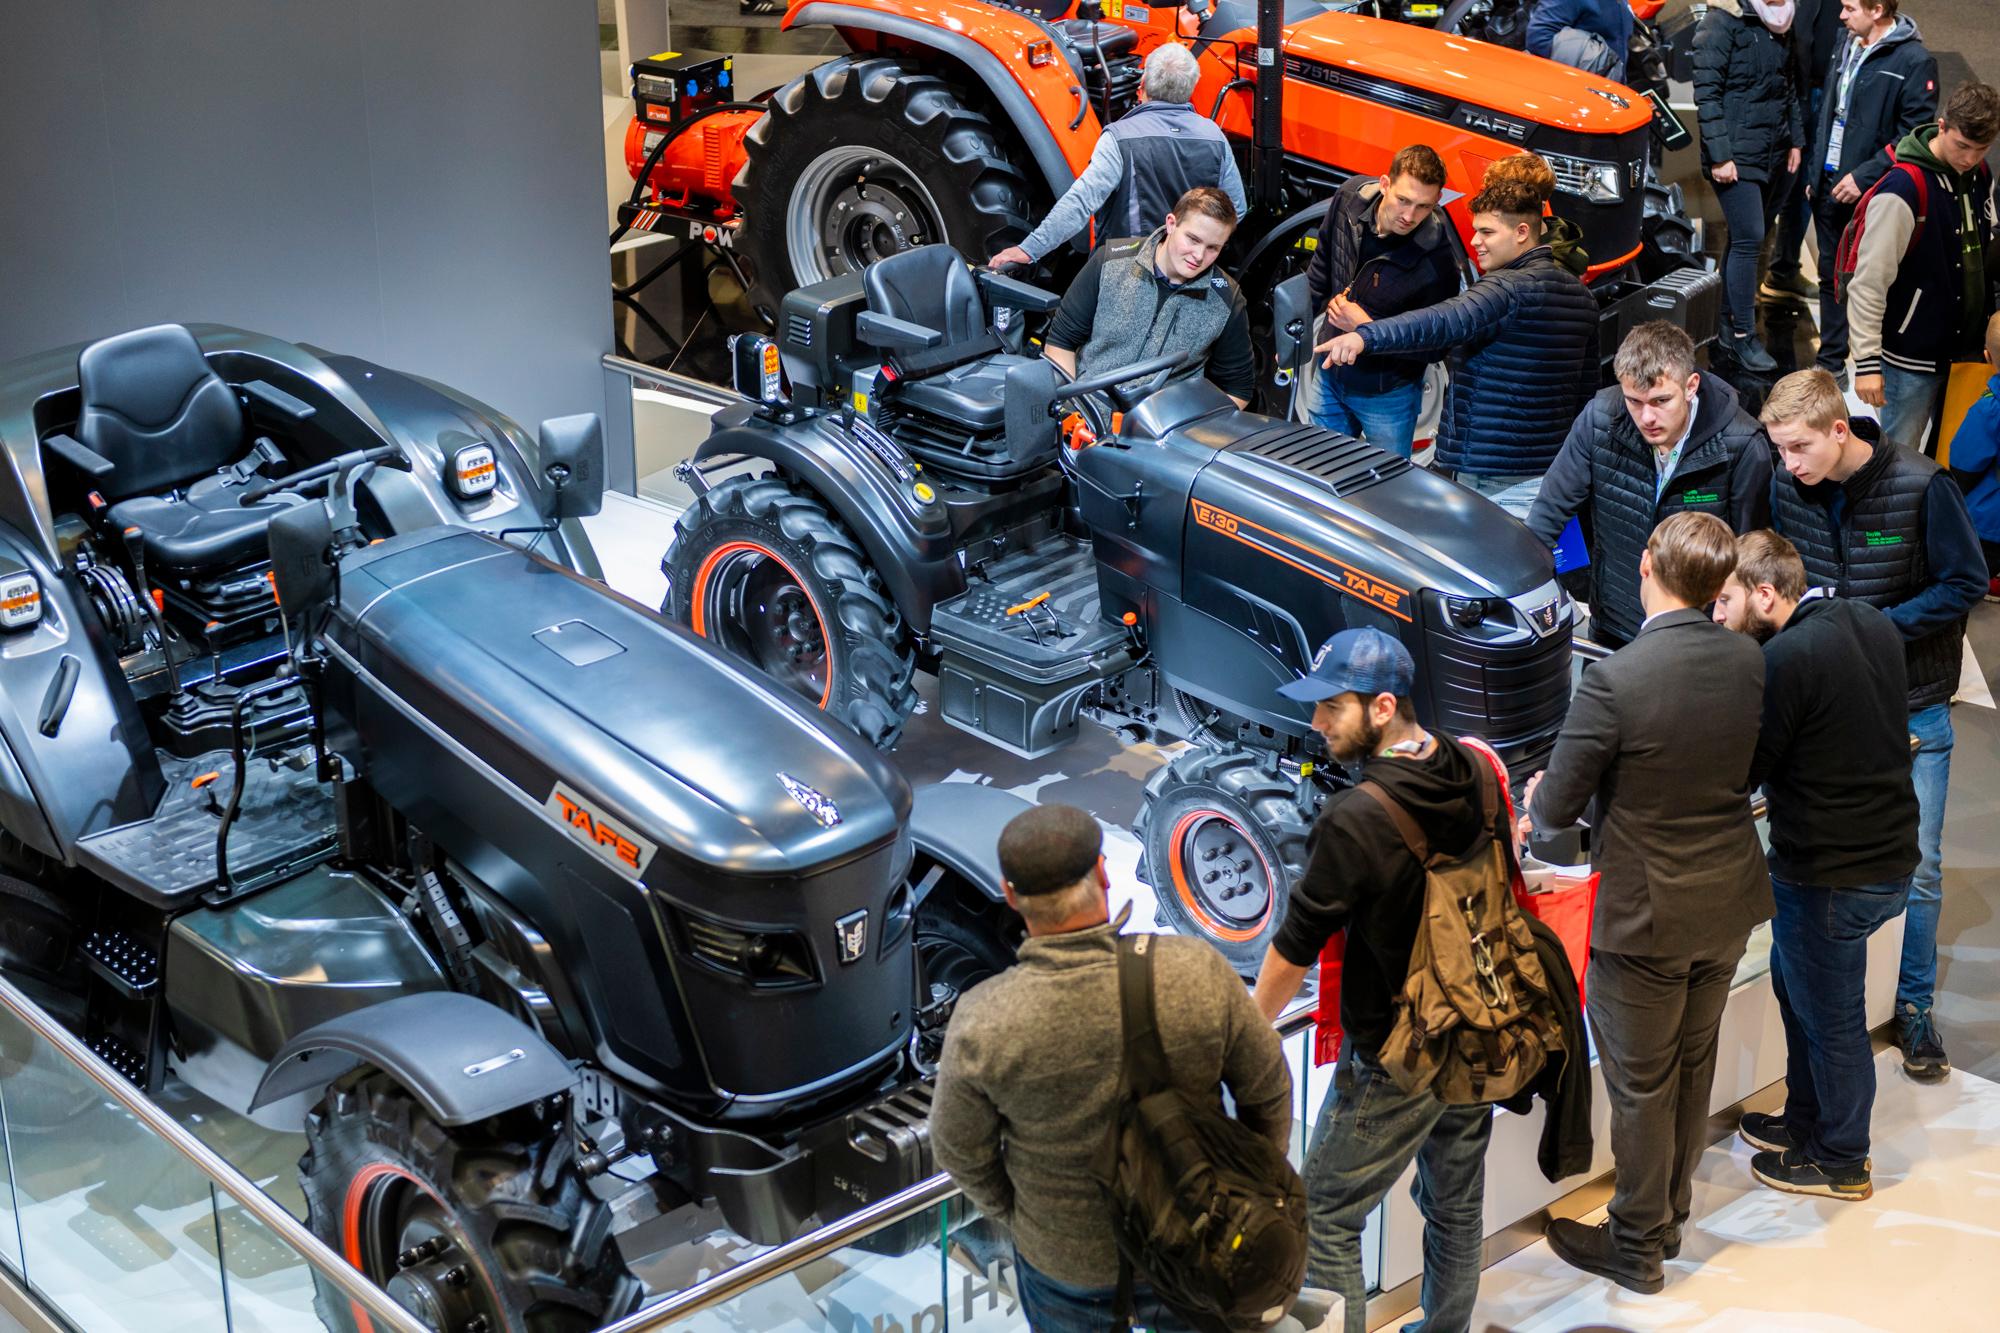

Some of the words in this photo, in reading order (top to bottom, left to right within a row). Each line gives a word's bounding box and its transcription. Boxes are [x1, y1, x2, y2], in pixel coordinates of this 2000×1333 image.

[1301, 62, 1341, 84] 7515
[1461, 107, 1526, 140] TAFE
[1343, 570, 1400, 608] TAFE
[555, 791, 641, 869] TAFE
